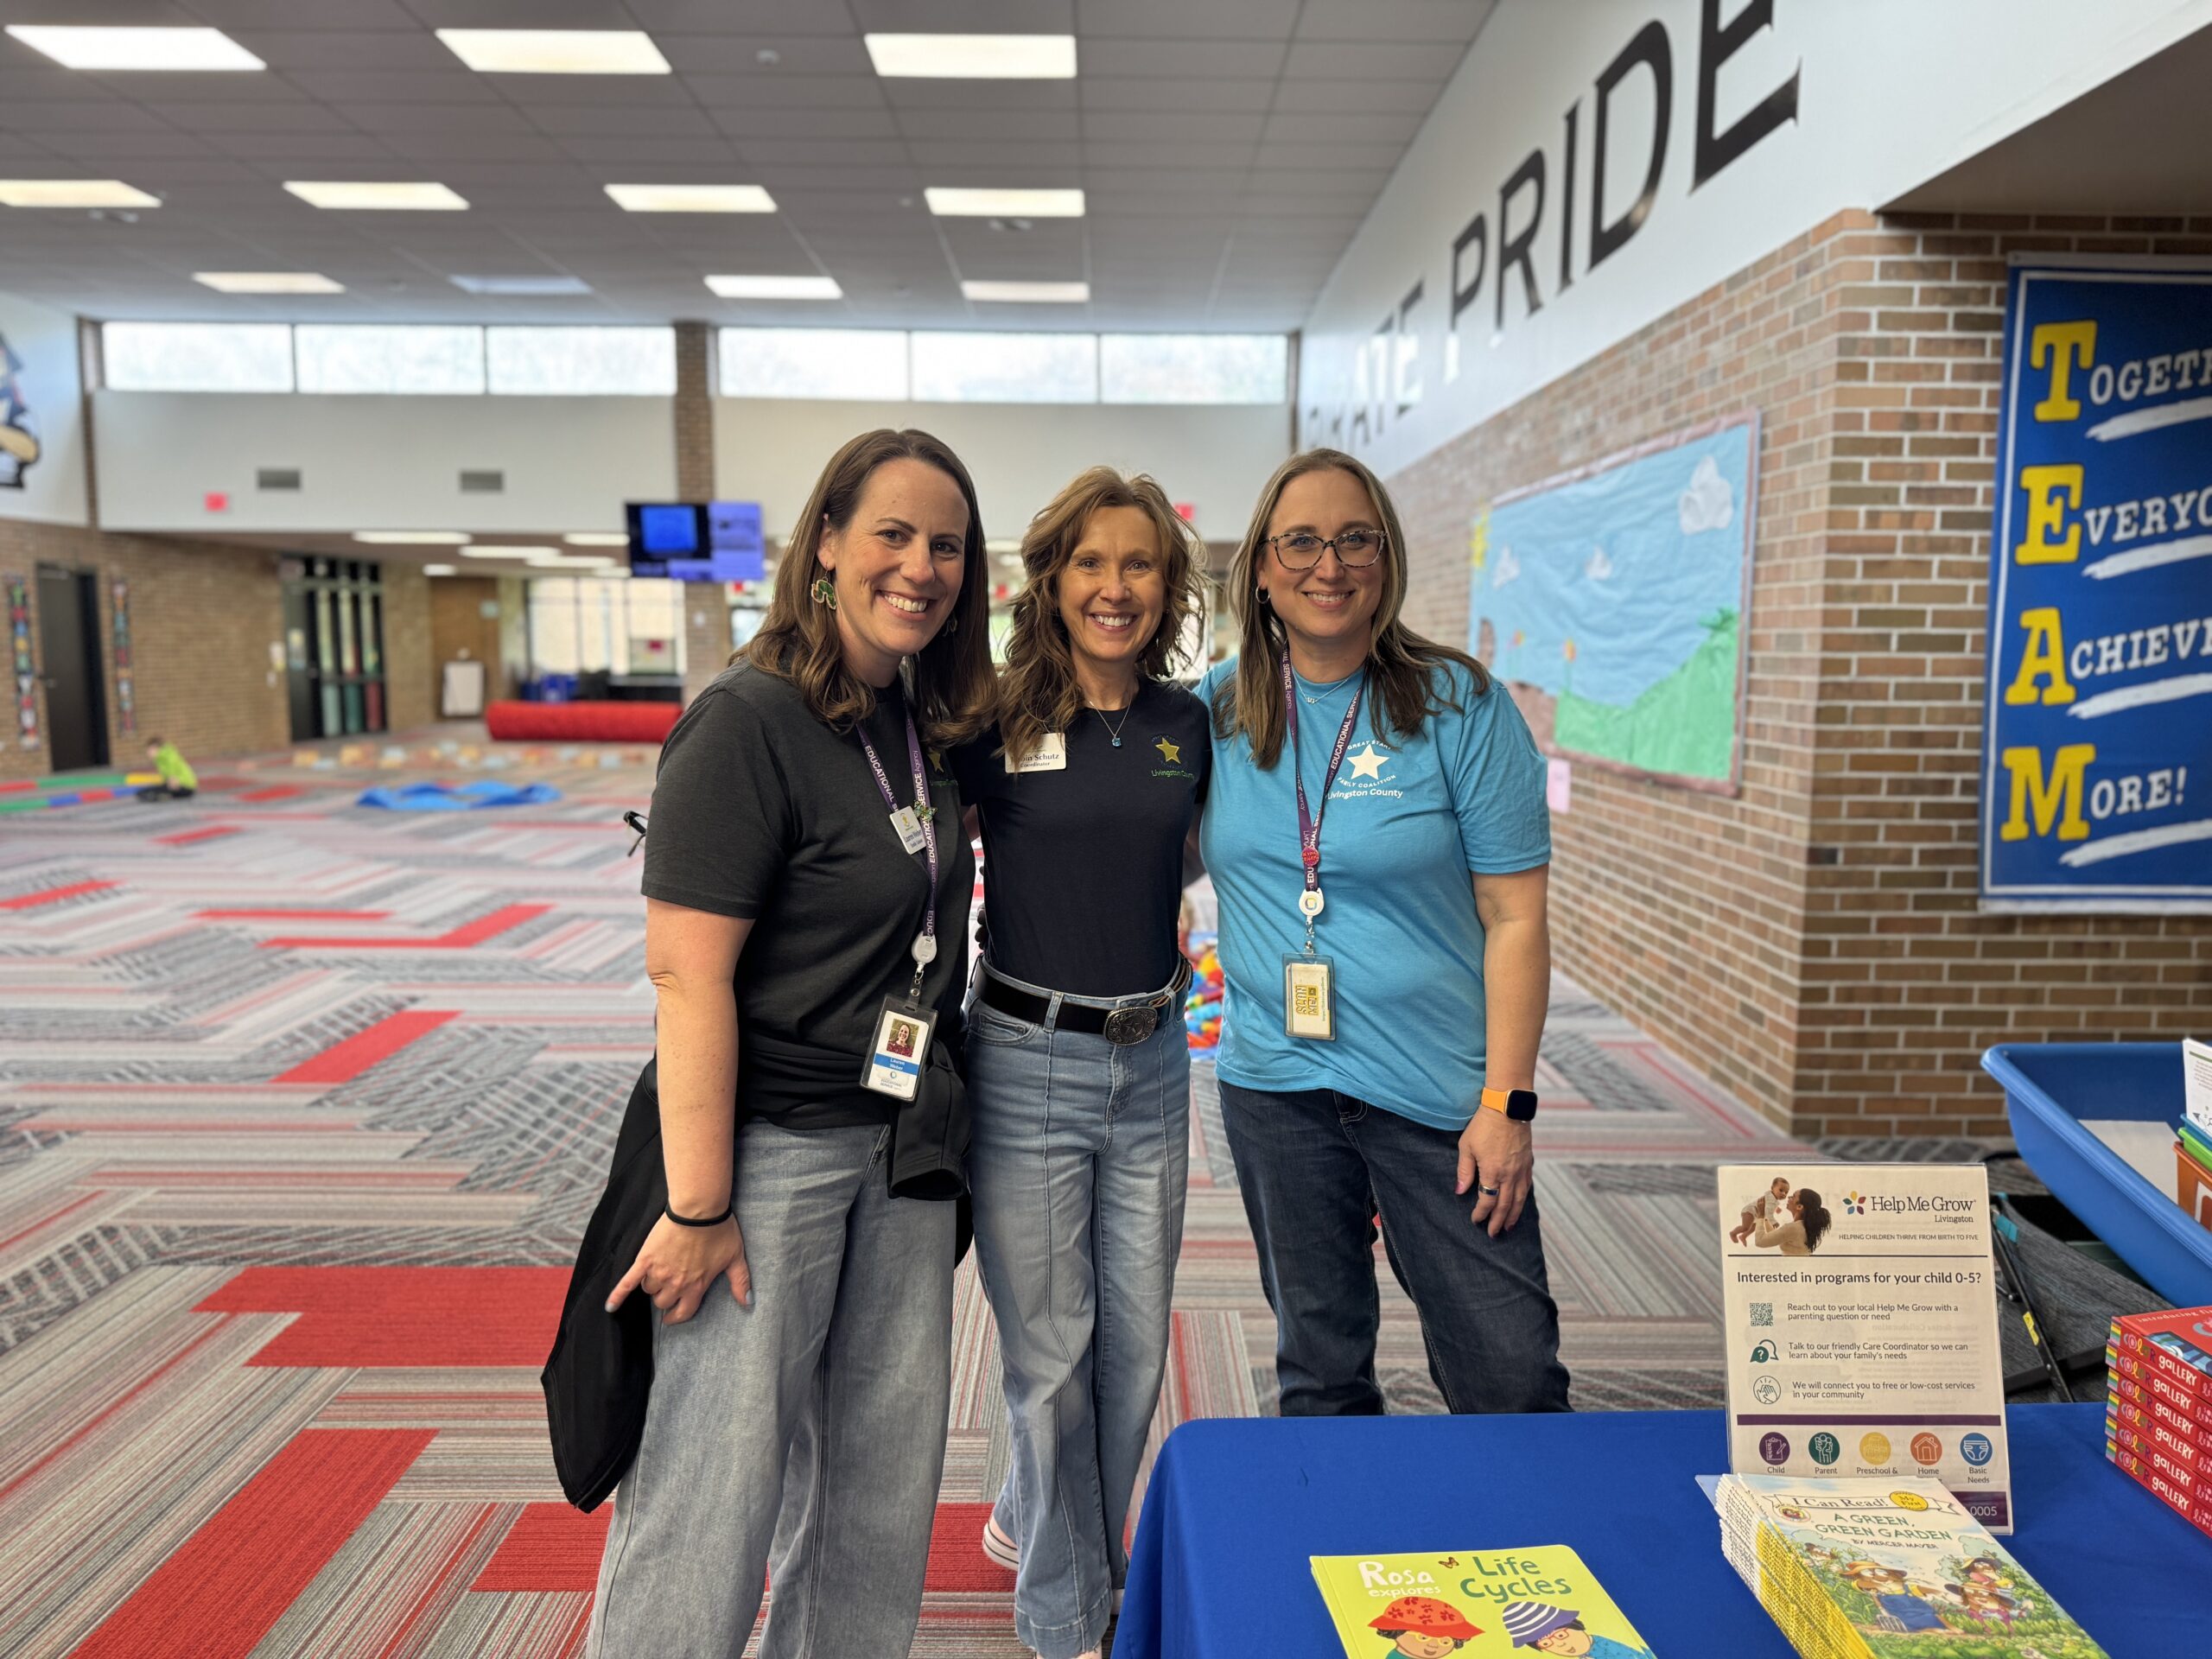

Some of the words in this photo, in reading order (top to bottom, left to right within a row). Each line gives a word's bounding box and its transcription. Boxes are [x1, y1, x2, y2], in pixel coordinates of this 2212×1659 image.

[1445, 0, 1803, 385] PRIDE
[1330, 720, 1351, 771] EDUCATIONAL
[1347, 741, 1370, 750] GREAT
[864, 745, 896, 803] EDUCATIONAL
[1357, 774, 1397, 788] COALITION
[914, 772, 927, 807] SERVICE
[1327, 790, 1368, 799] Livingston
[1370, 788, 1403, 799] County
[1999, 743, 2188, 842] MORE!
[1871, 1196, 1905, 1213] Help
[1906, 1196, 1929, 1211] Me
[1931, 1196, 1973, 1211] Grow
[1935, 1215, 1974, 1224] Livingston
[1738, 1272, 1797, 1283] Interested
[1801, 1272, 1812, 1283] in
[1815, 1274, 1871, 1285] programs
[1873, 1272, 1891, 1283] for
[1894, 1274, 1921, 1285] your
[1924, 1272, 1952, 1283] child
[1955, 1272, 1981, 1283] 0-5?
[1788, 1313, 1824, 1321] parenting
[1827, 1313, 1859, 1321] question
[2136, 1312, 2199, 1323] introducing
[1832, 1343, 1860, 1351] friendly
[1853, 1351, 1882, 1361] family's
[1821, 1391, 1865, 1400] community
[1967, 1476, 1990, 1484] Needs
[1803, 1497, 1839, 1506] Can
[1840, 1498, 1888, 1507] Read!
[1850, 1514, 1916, 1528] GREEN,
[1815, 1524, 1875, 1537] GREEN
[1878, 1528, 1952, 1541] GARDEN
[1471, 1556, 1541, 1577] Life
[1357, 1560, 1435, 1588] Rosa
[1368, 1585, 1442, 1599] explores
[1459, 1578, 1573, 1604] Cycles
